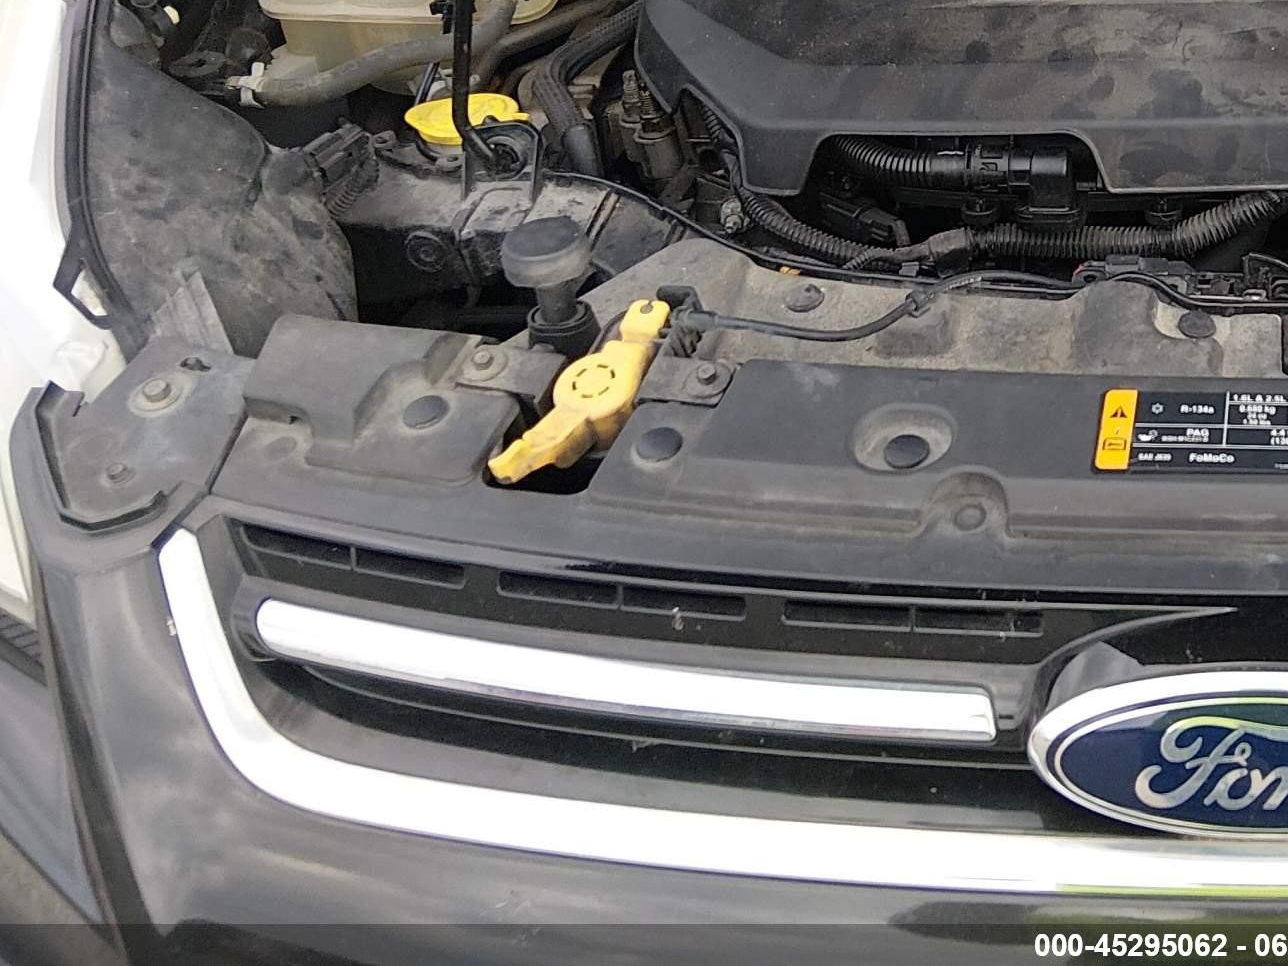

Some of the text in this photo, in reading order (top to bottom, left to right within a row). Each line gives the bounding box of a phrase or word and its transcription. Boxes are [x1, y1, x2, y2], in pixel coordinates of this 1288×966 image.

[1180, 404, 1215, 414] R-134a
[1186, 428, 1209, 436] PAG
[1189, 452, 1235, 463] FoMoCo
